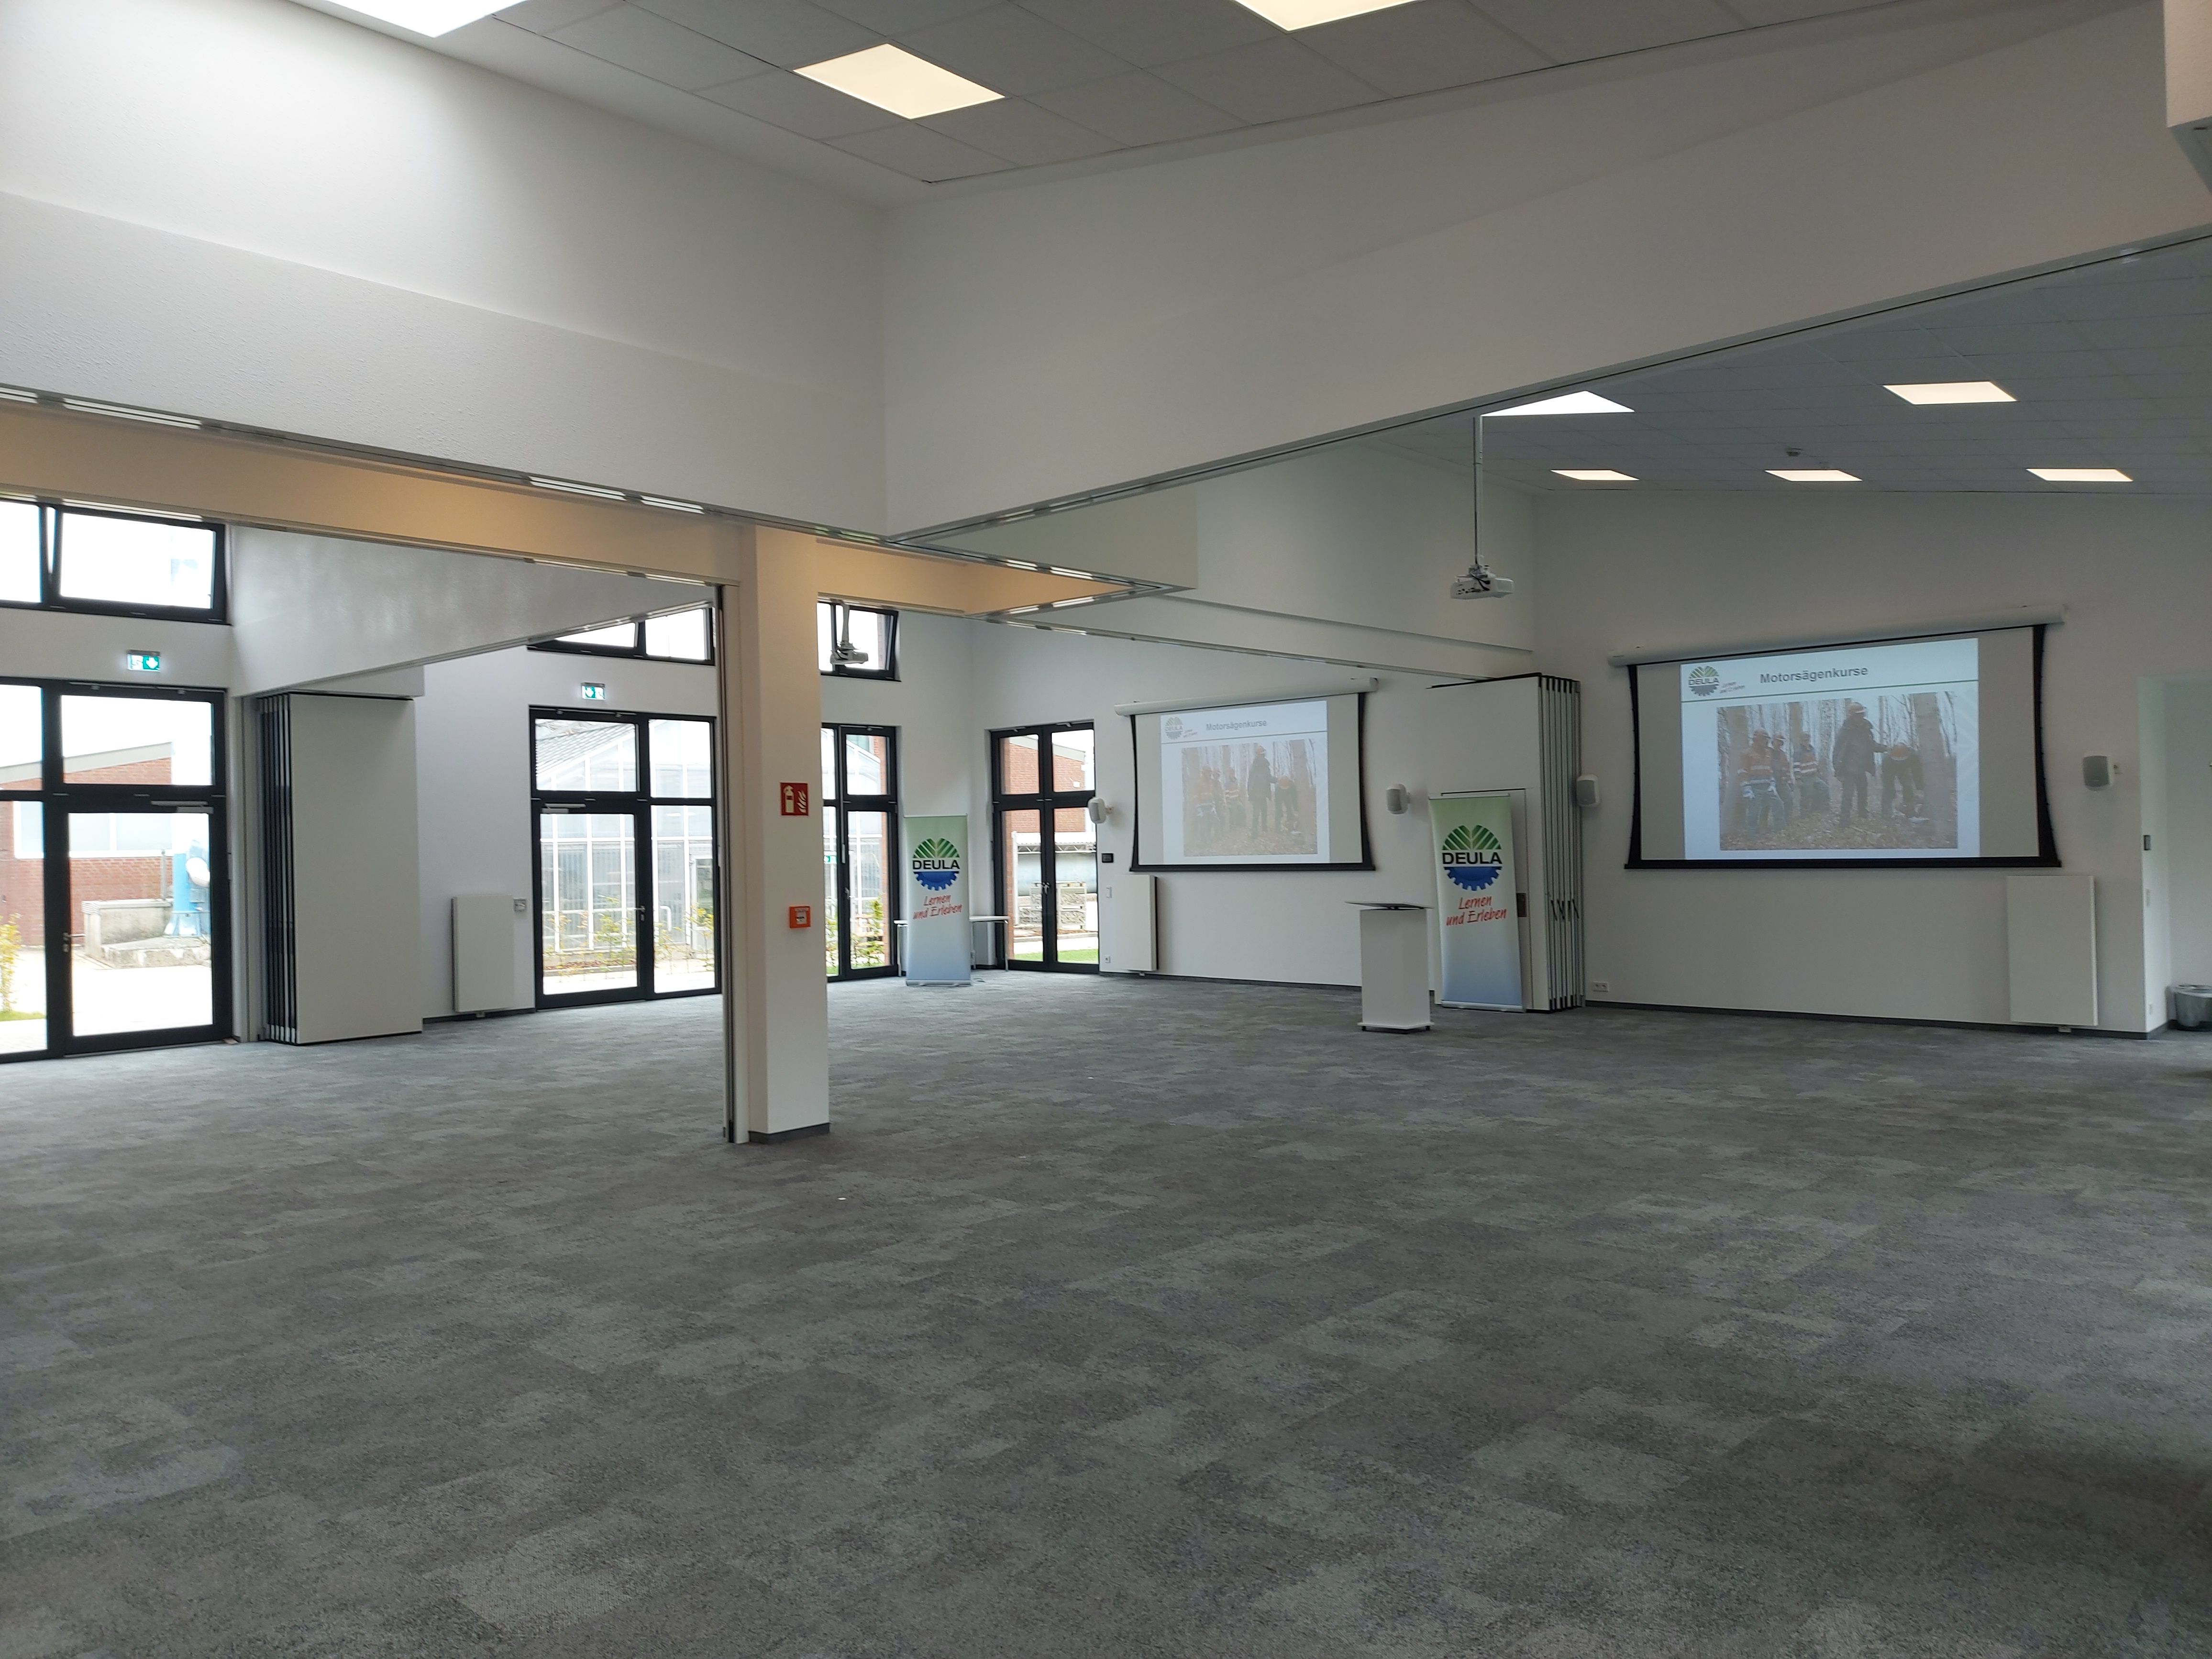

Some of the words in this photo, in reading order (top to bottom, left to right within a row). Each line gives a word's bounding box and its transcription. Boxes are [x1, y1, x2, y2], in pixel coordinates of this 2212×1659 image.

[1759, 667, 1869, 683] Motorsägenkurse
[1206, 719, 1267, 730] Motorsägenkurse
[1442, 852, 1503, 864] DEULA
[912, 860, 960, 870] DEULA
[923, 895, 951, 906] Lernen
[1458, 896, 1492, 909] Lernen
[1446, 912, 1465, 926] und
[1467, 907, 1507, 923] Erleben
